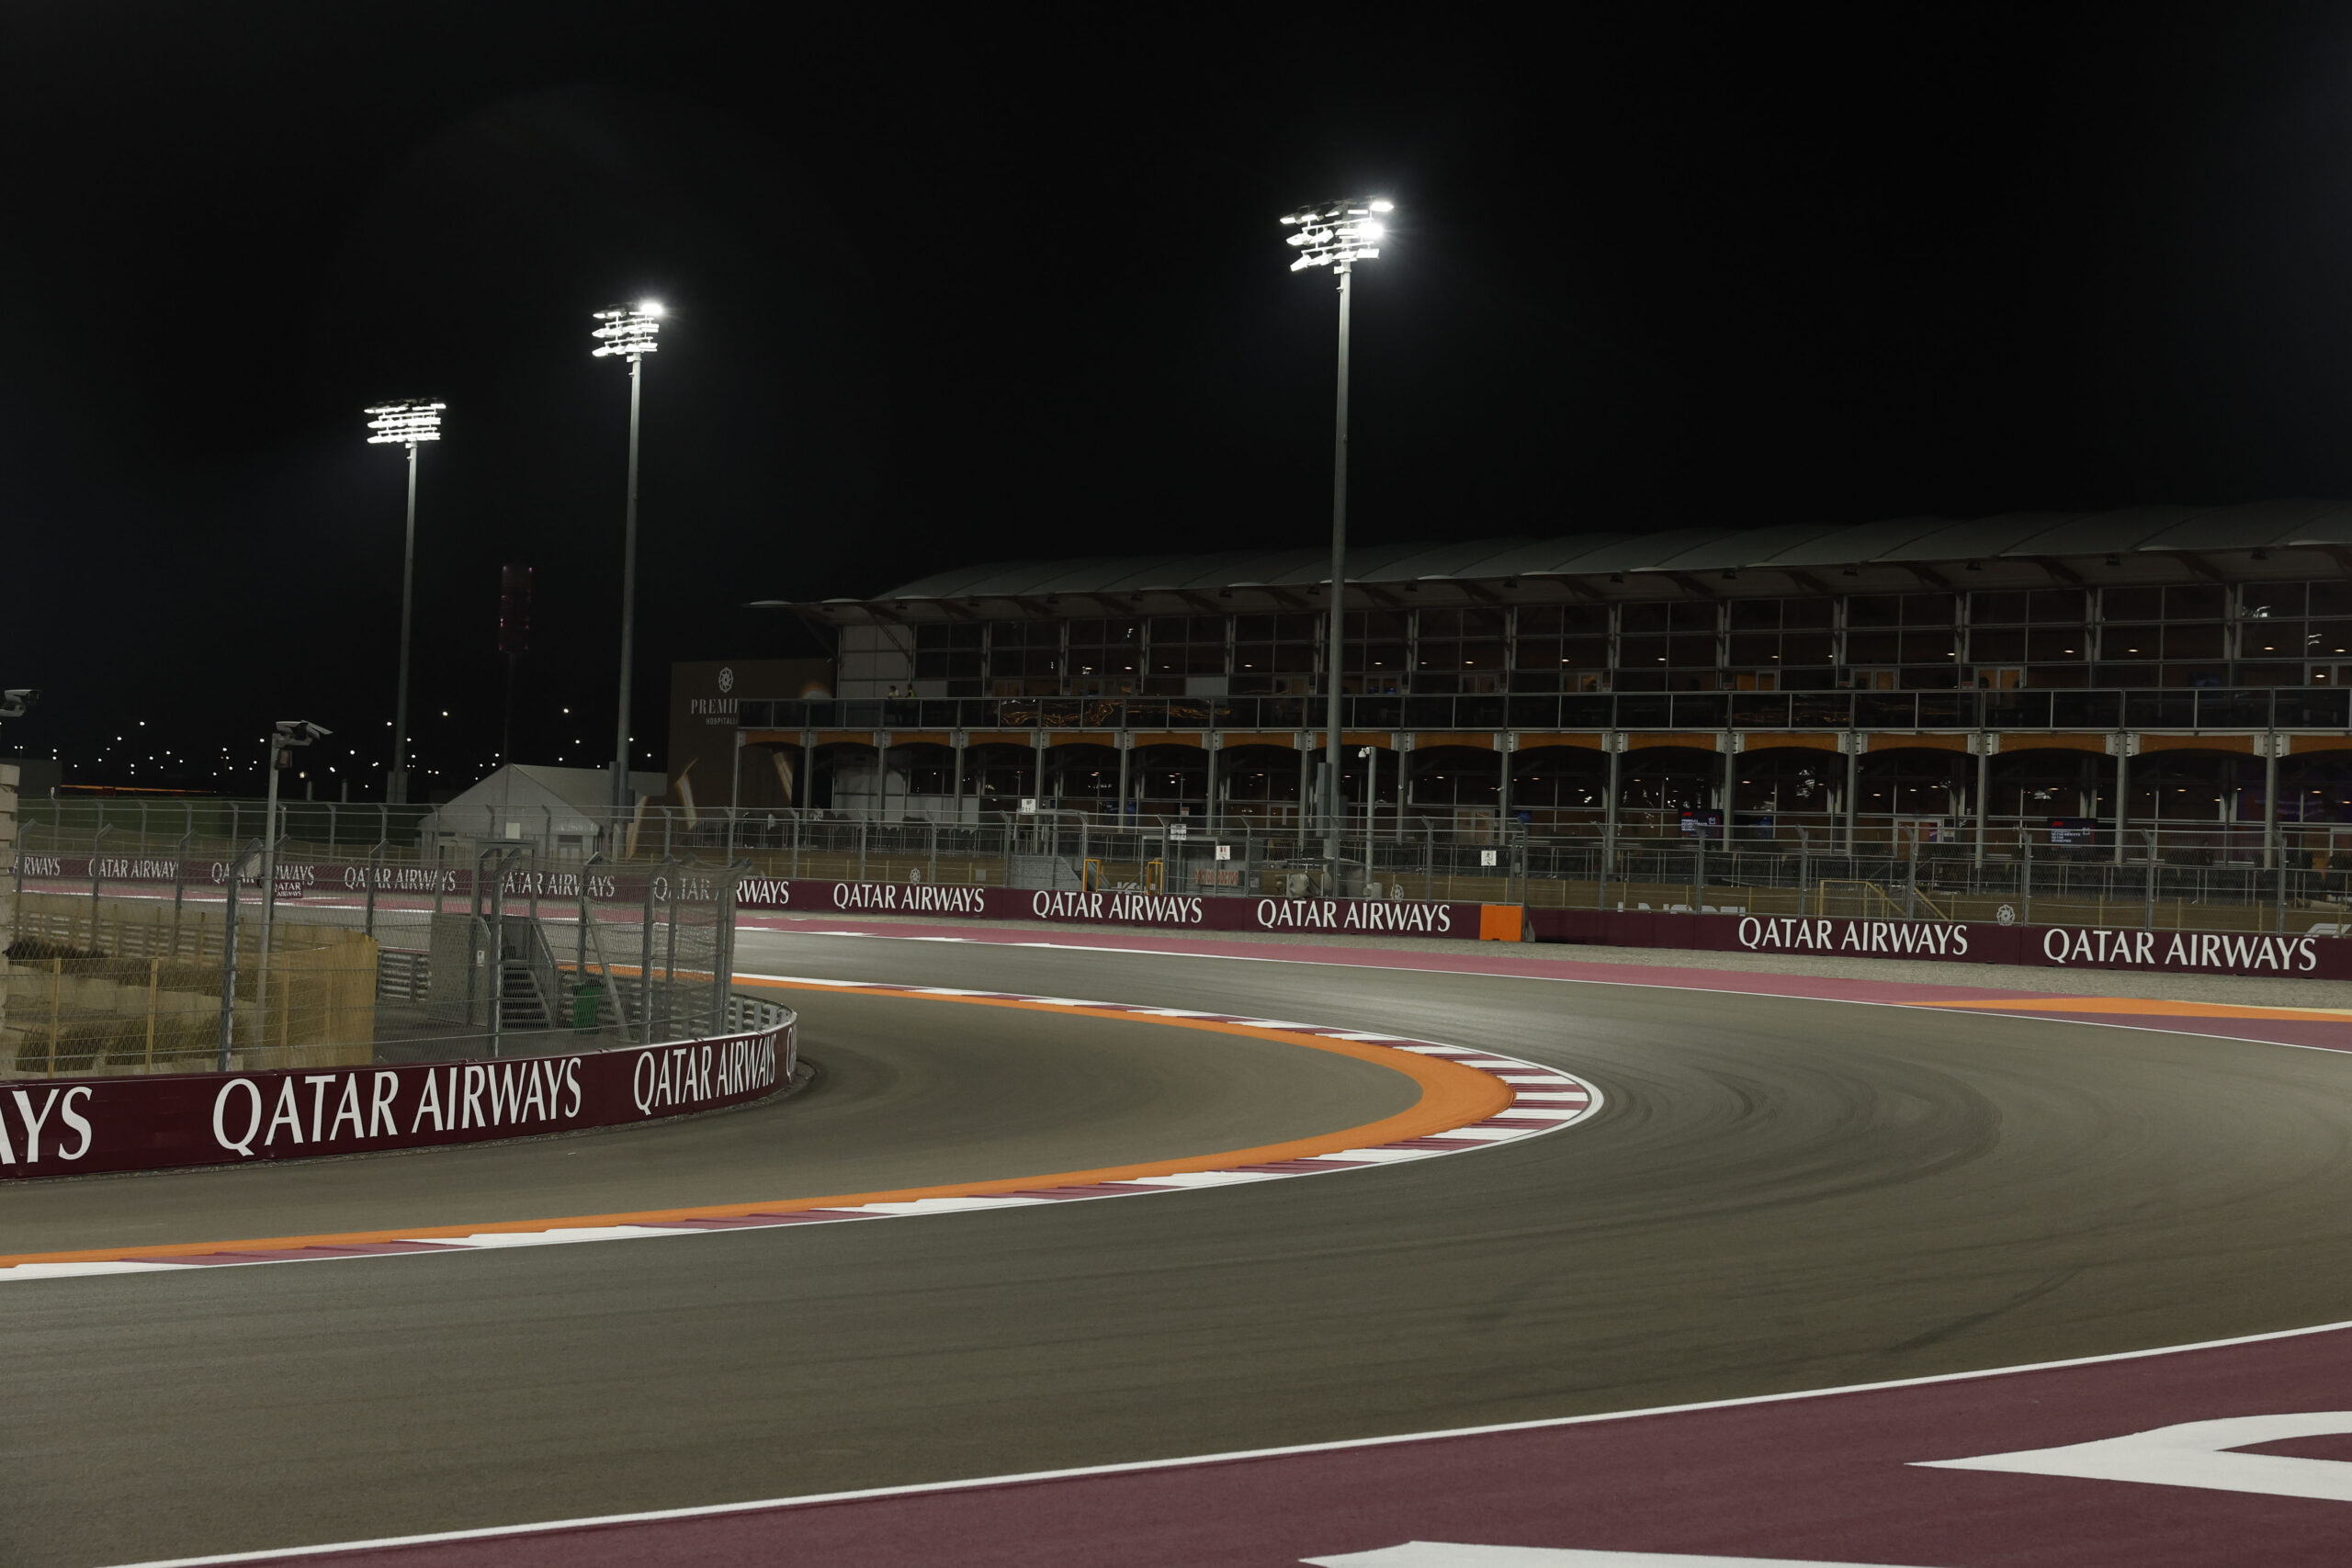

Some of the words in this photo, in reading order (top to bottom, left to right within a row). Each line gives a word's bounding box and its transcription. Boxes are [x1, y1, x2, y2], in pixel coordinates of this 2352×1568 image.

[834, 884, 895, 908] QATAR
[901, 886, 984, 912] AIRWAYS
[1033, 890, 1102, 918] QATAR
[1109, 895, 1202, 923] AIRWAYS
[1258, 899, 1337, 928] QATAR
[1344, 902, 1450, 931] AIRWAYS
[1739, 917, 1832, 949] QATAR
[1841, 921, 1967, 954] AIRWAYS
[2044, 929, 2154, 964] QATAR
[2165, 933, 2316, 970] AIRWAYS
[634, 1046, 711, 1115] QATAR
[717, 1035, 775, 1097] AIRWAYS
[213, 1071, 398, 1156] QATAR
[413, 1057, 582, 1133] AIRWAYS
